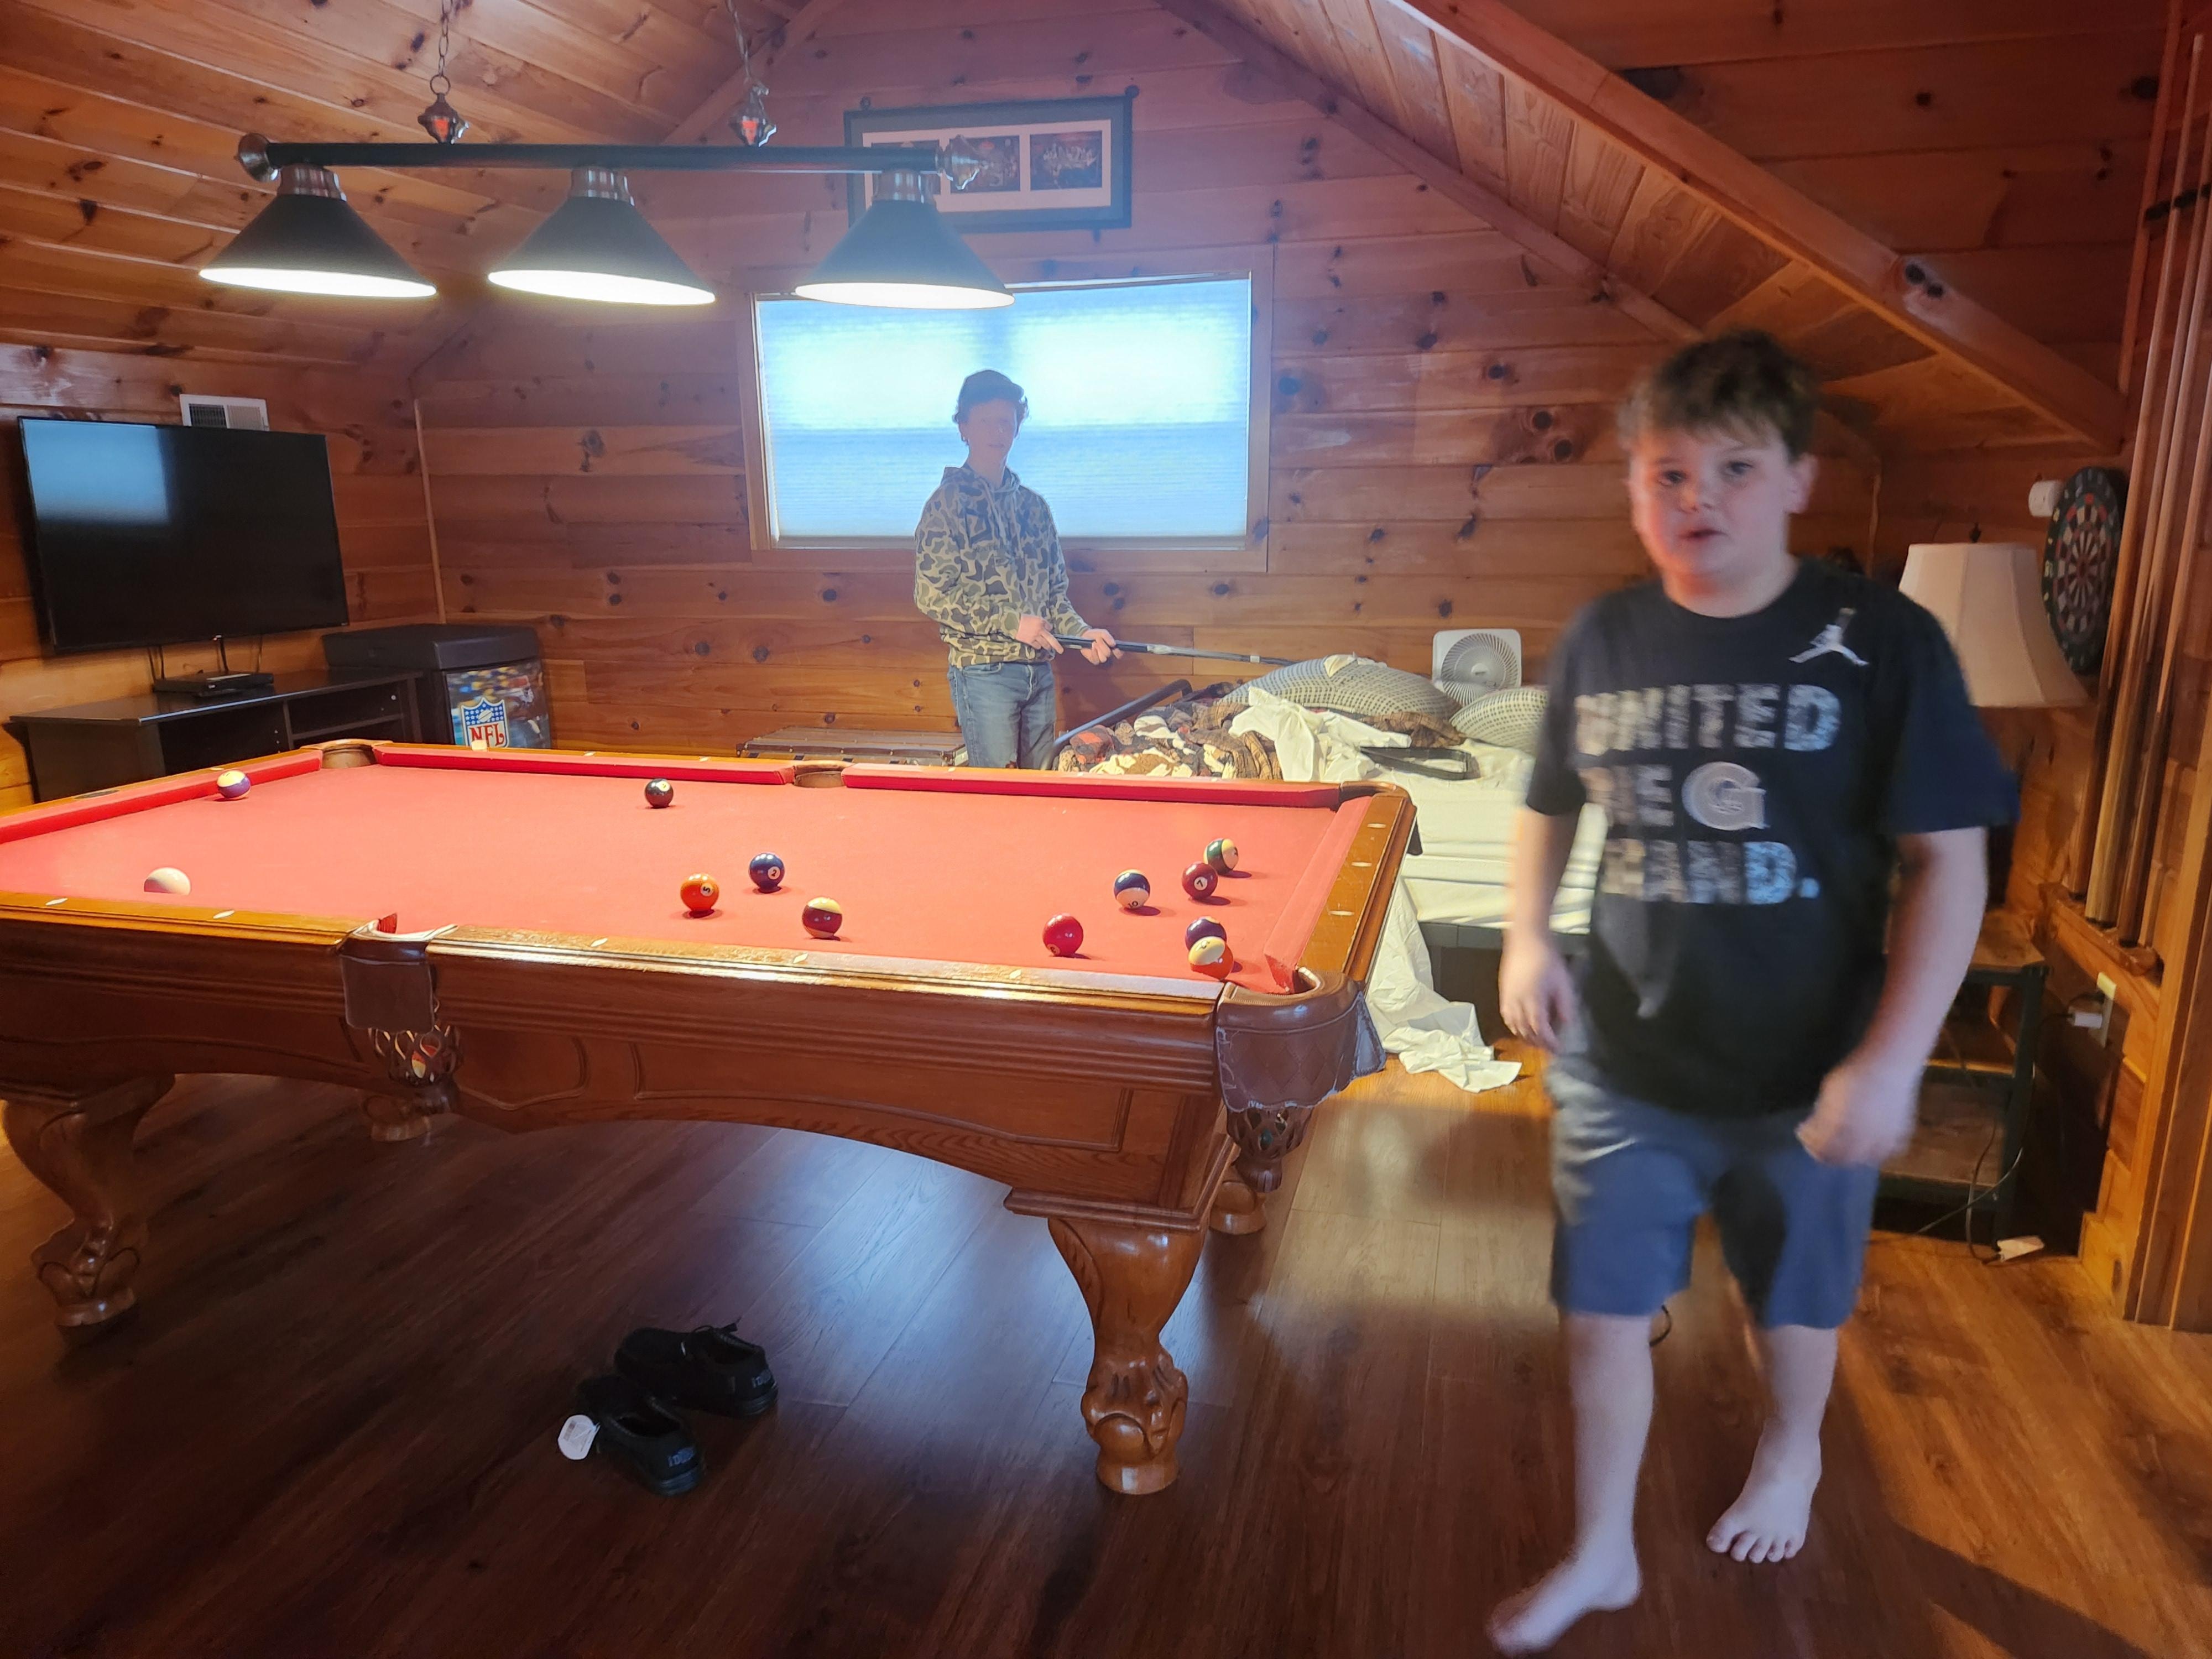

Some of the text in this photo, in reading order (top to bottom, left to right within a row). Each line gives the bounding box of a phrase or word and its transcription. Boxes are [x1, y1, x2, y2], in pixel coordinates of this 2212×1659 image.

[469, 723, 504, 747] NFL
[1682, 761, 1770, 831] G
[771, 869, 777, 877] 2
[1196, 879, 1204, 888] 7
[1128, 900, 1139, 909] 10
